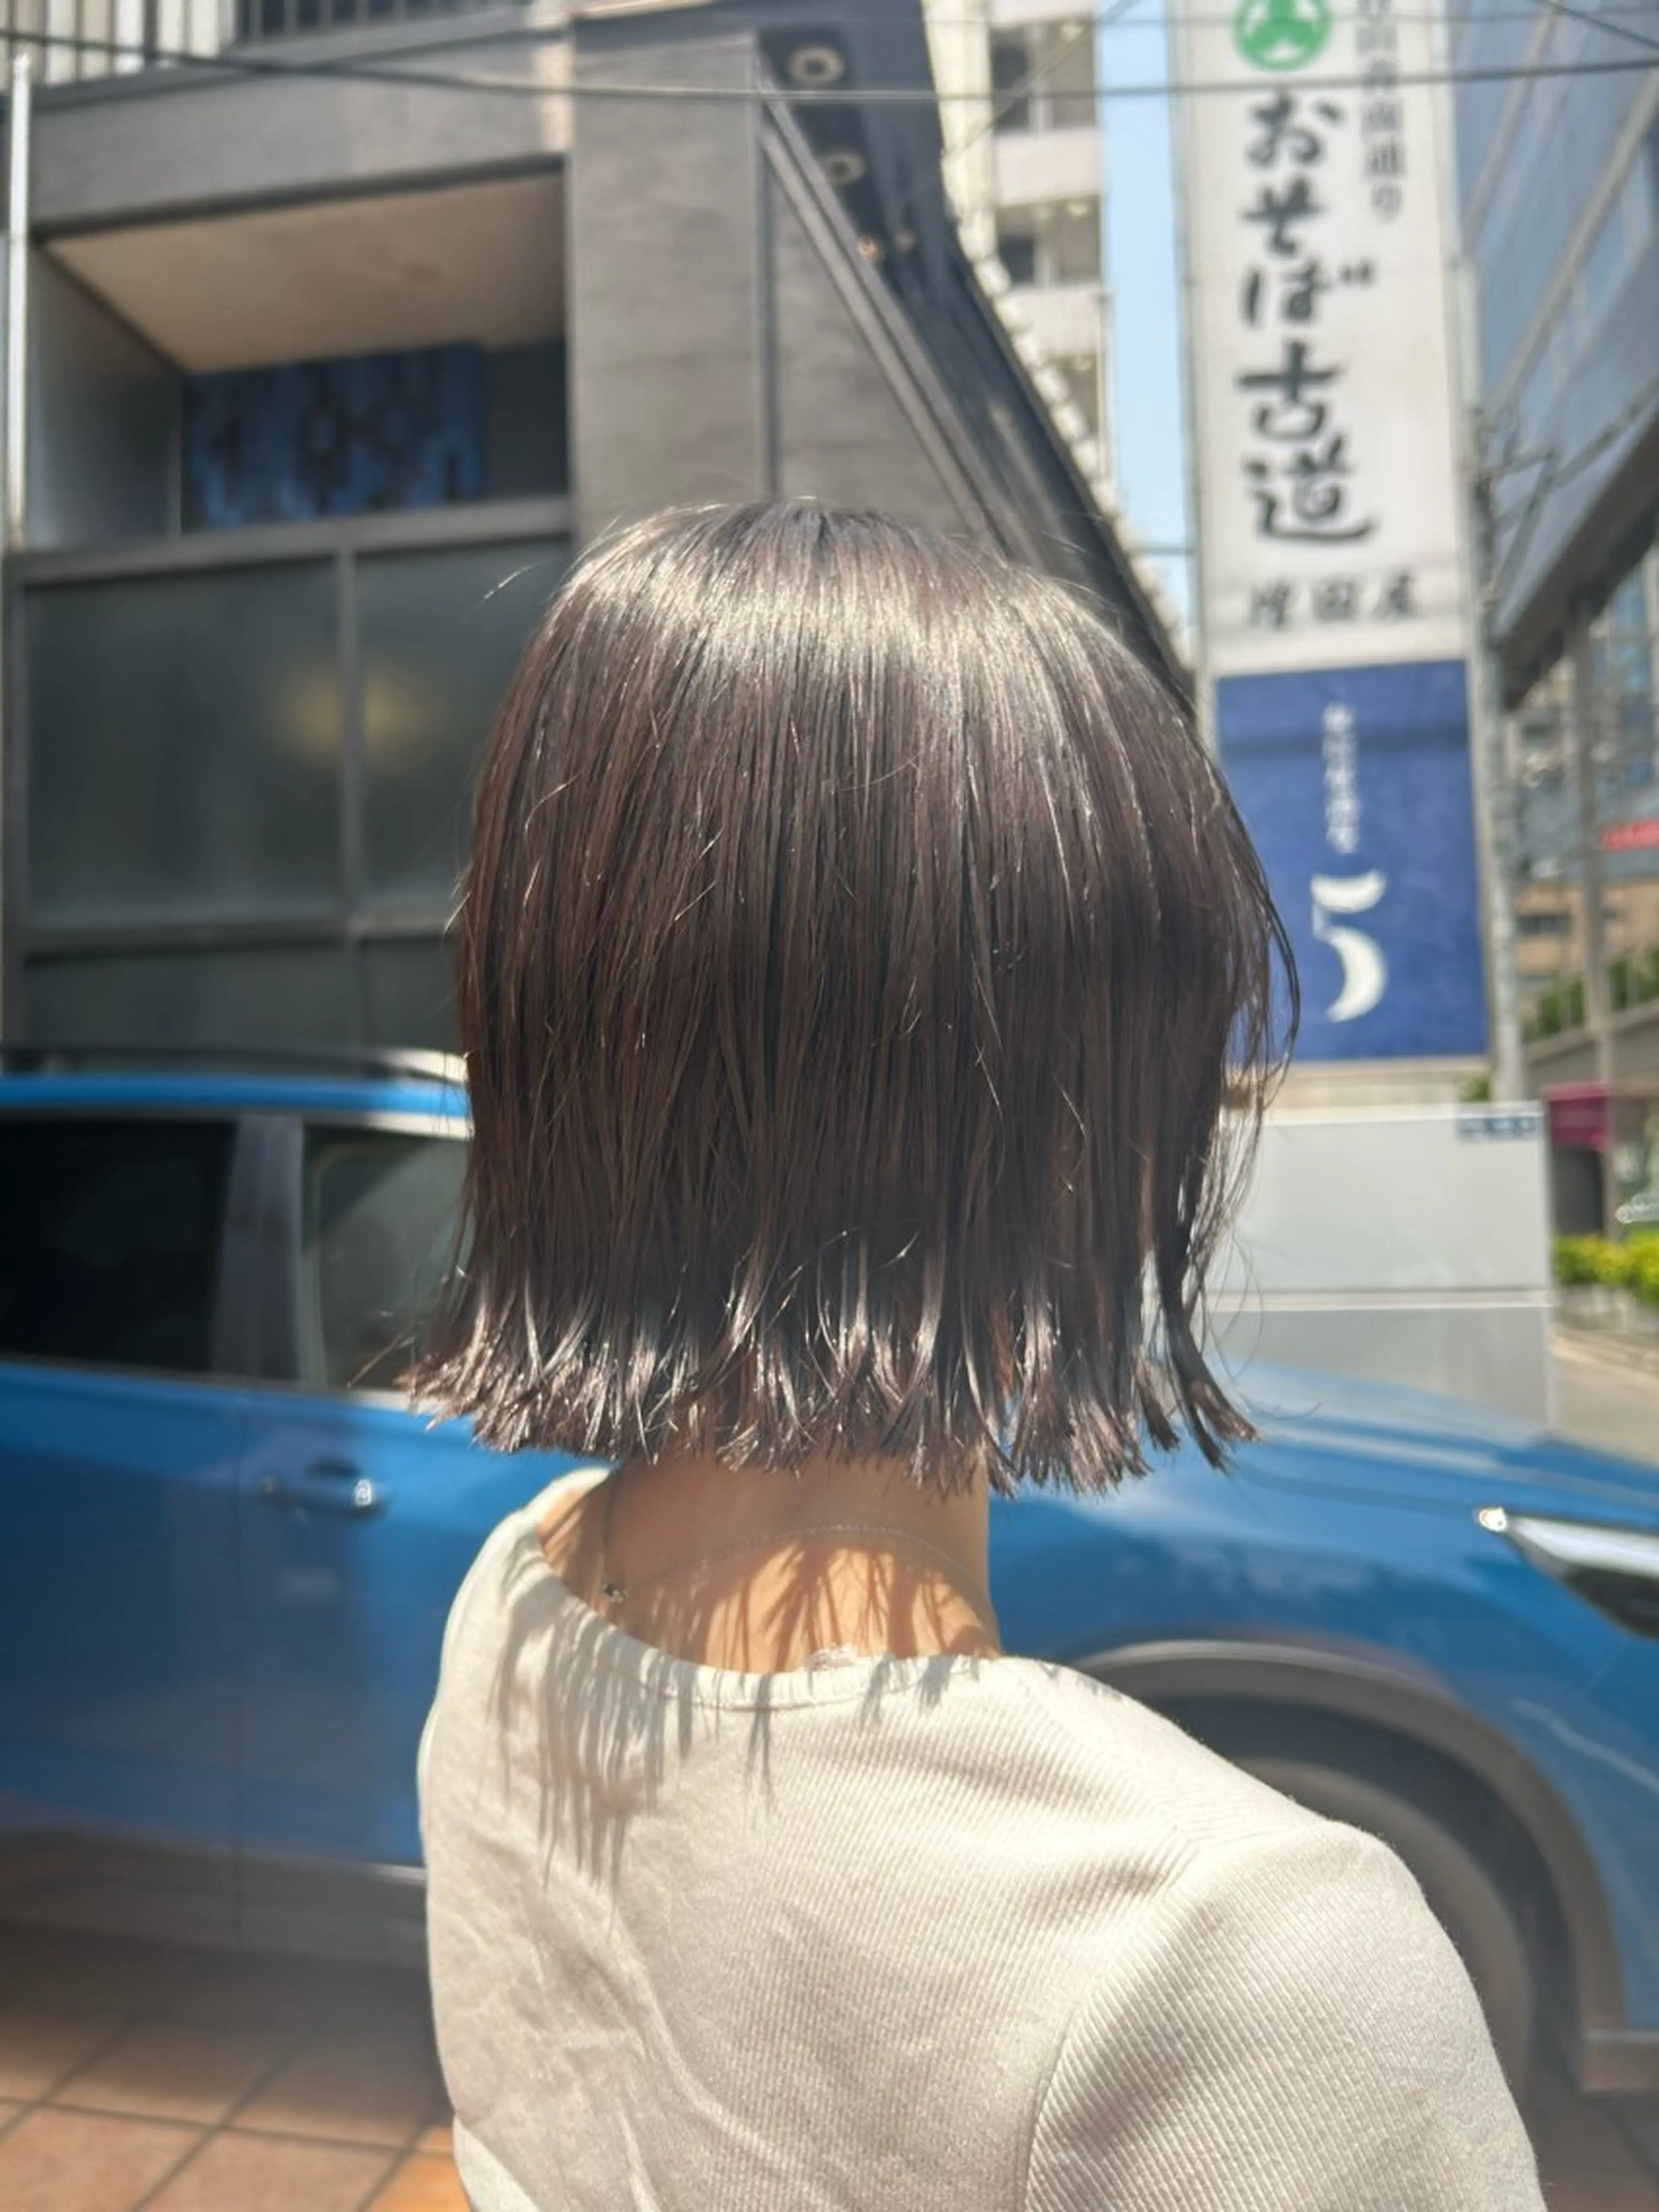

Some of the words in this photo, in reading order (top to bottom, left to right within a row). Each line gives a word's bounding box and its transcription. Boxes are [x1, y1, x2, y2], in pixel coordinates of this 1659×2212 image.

[1235, 88, 1376, 544] おそば古道
